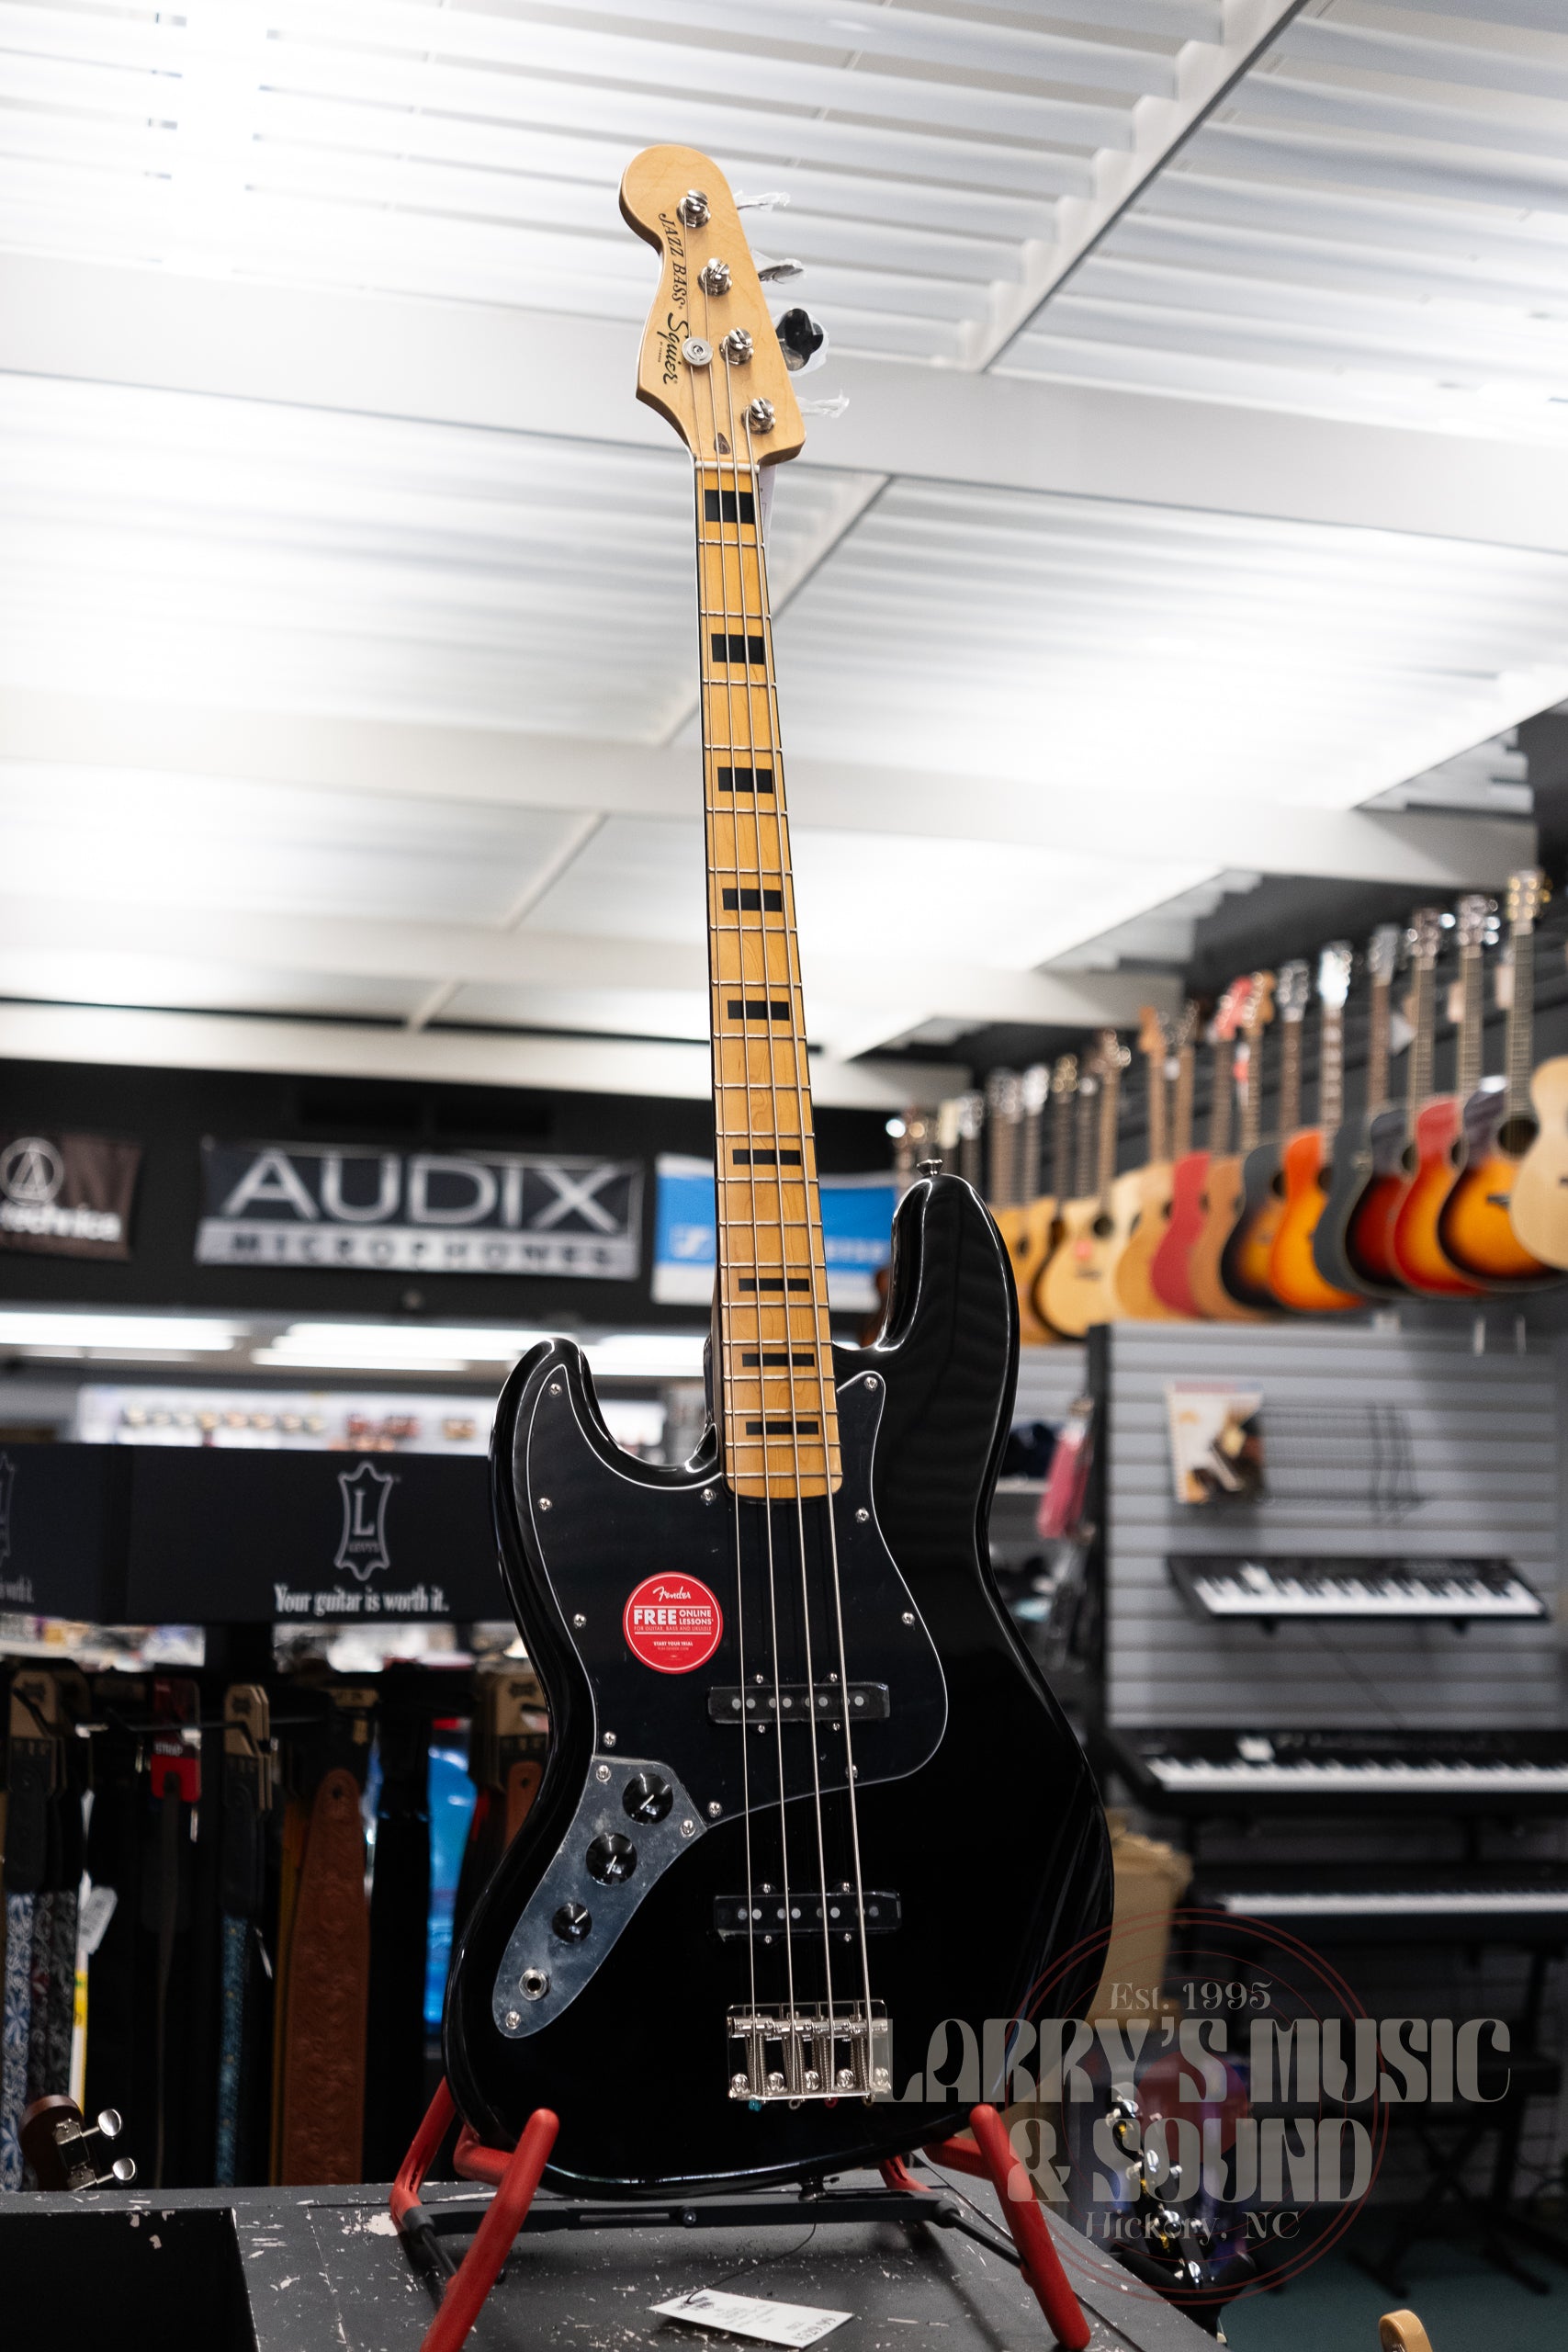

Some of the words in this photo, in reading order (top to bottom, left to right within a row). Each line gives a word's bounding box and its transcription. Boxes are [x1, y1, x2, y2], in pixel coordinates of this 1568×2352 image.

[659, 212, 684, 257] JAZZ
[657, 312, 691, 385] Squier
[220, 1147, 621, 1236] AUDIX
[230, 1231, 614, 1268] MICROPHONES
[353, 1489, 375, 1536] L
[275, 1583, 310, 1612] Your
[313, 1585, 363, 1617] guitar
[366, 1585, 380, 1612] is
[382, 1583, 429, 1612] worth
[431, 1585, 449, 1612] it.
[652, 1586, 692, 1602] Fender
[633, 1609, 677, 1625] FREE
[679, 1609, 712, 1617] ONLINE
